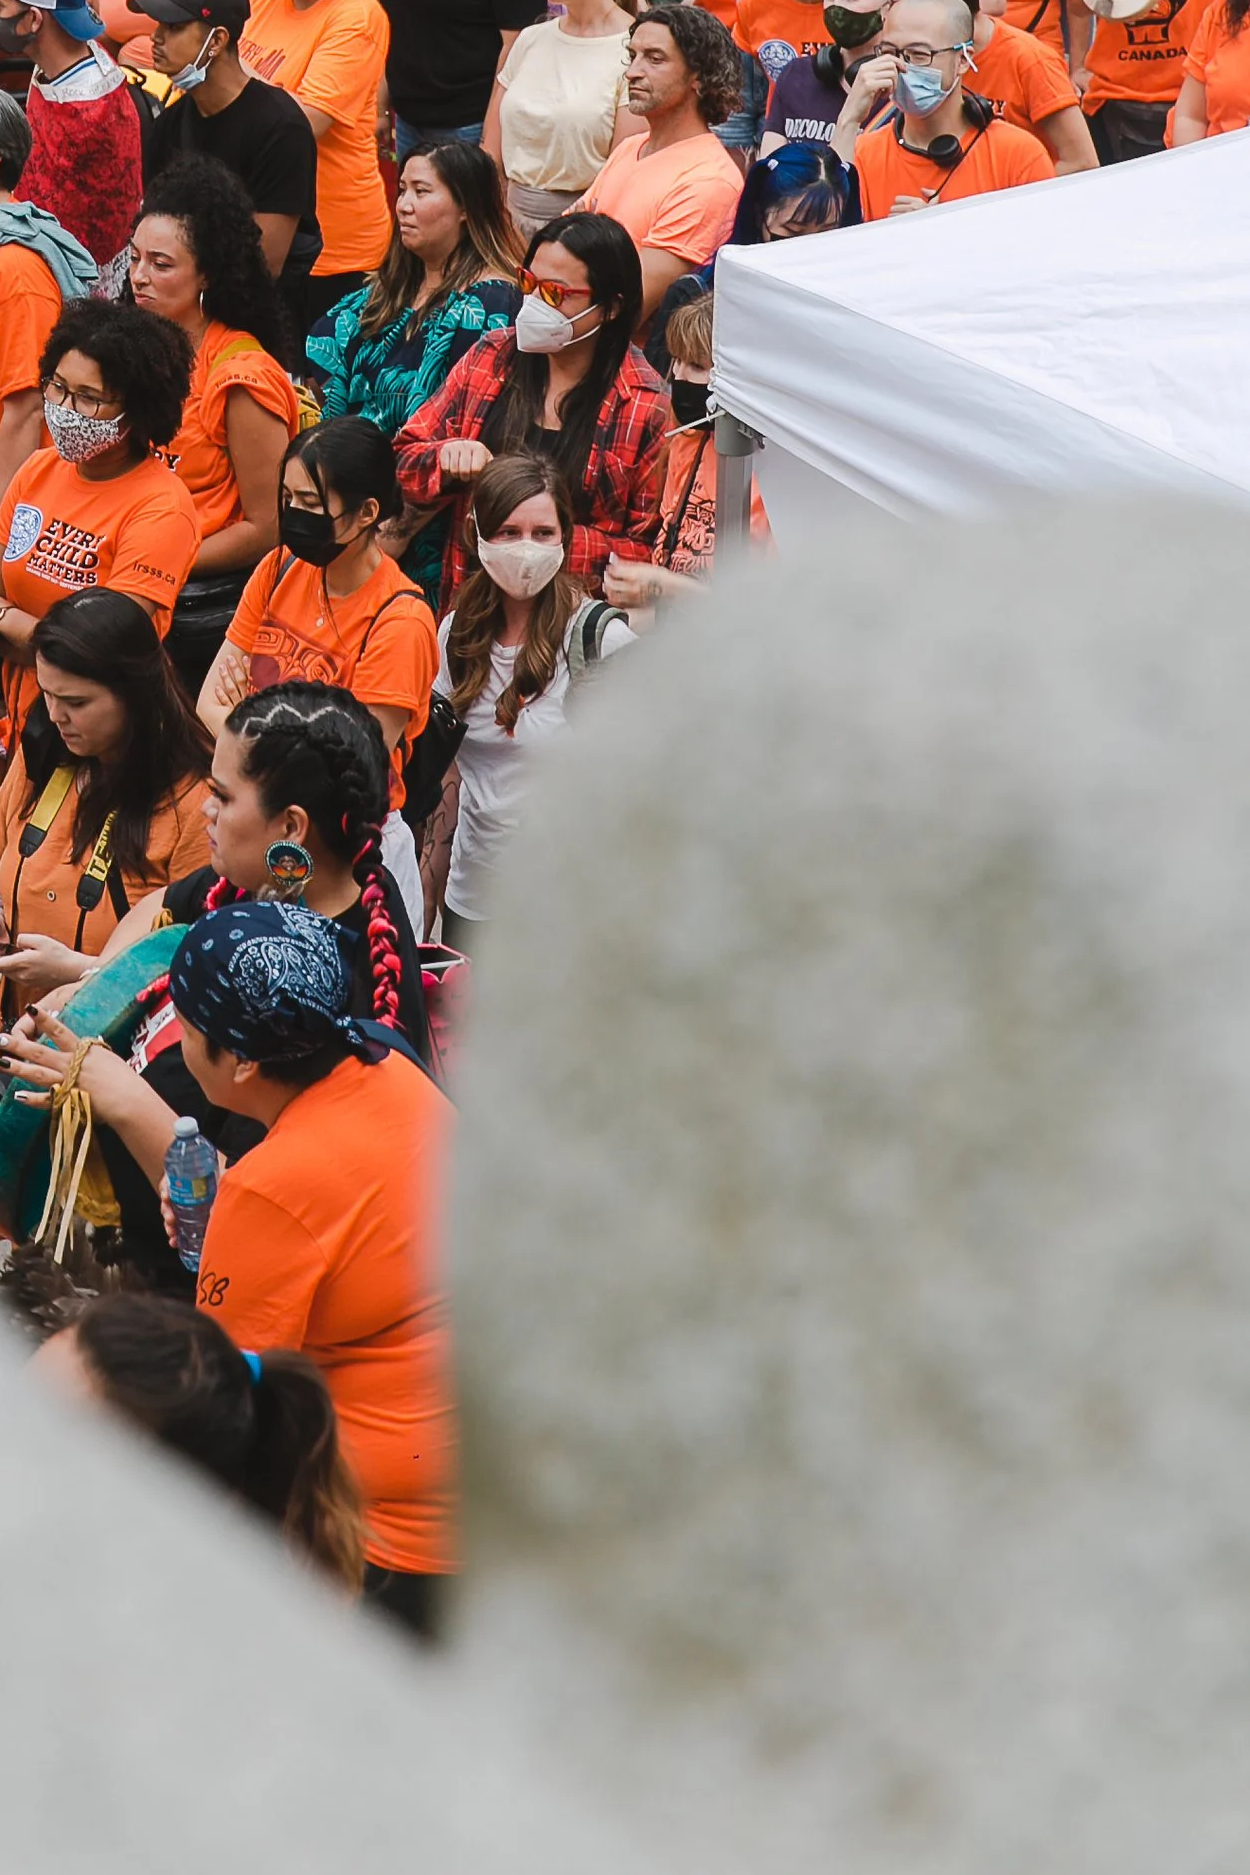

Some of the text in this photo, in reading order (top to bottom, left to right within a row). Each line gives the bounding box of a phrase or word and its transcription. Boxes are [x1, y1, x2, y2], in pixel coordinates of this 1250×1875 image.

[239, 37, 262, 63] VERY
[1117, 46, 1190, 63] CANADA
[44, 516, 107, 552] EVERY
[26, 553, 99, 586] MATTERS
[35, 535, 101, 571] CHILD
